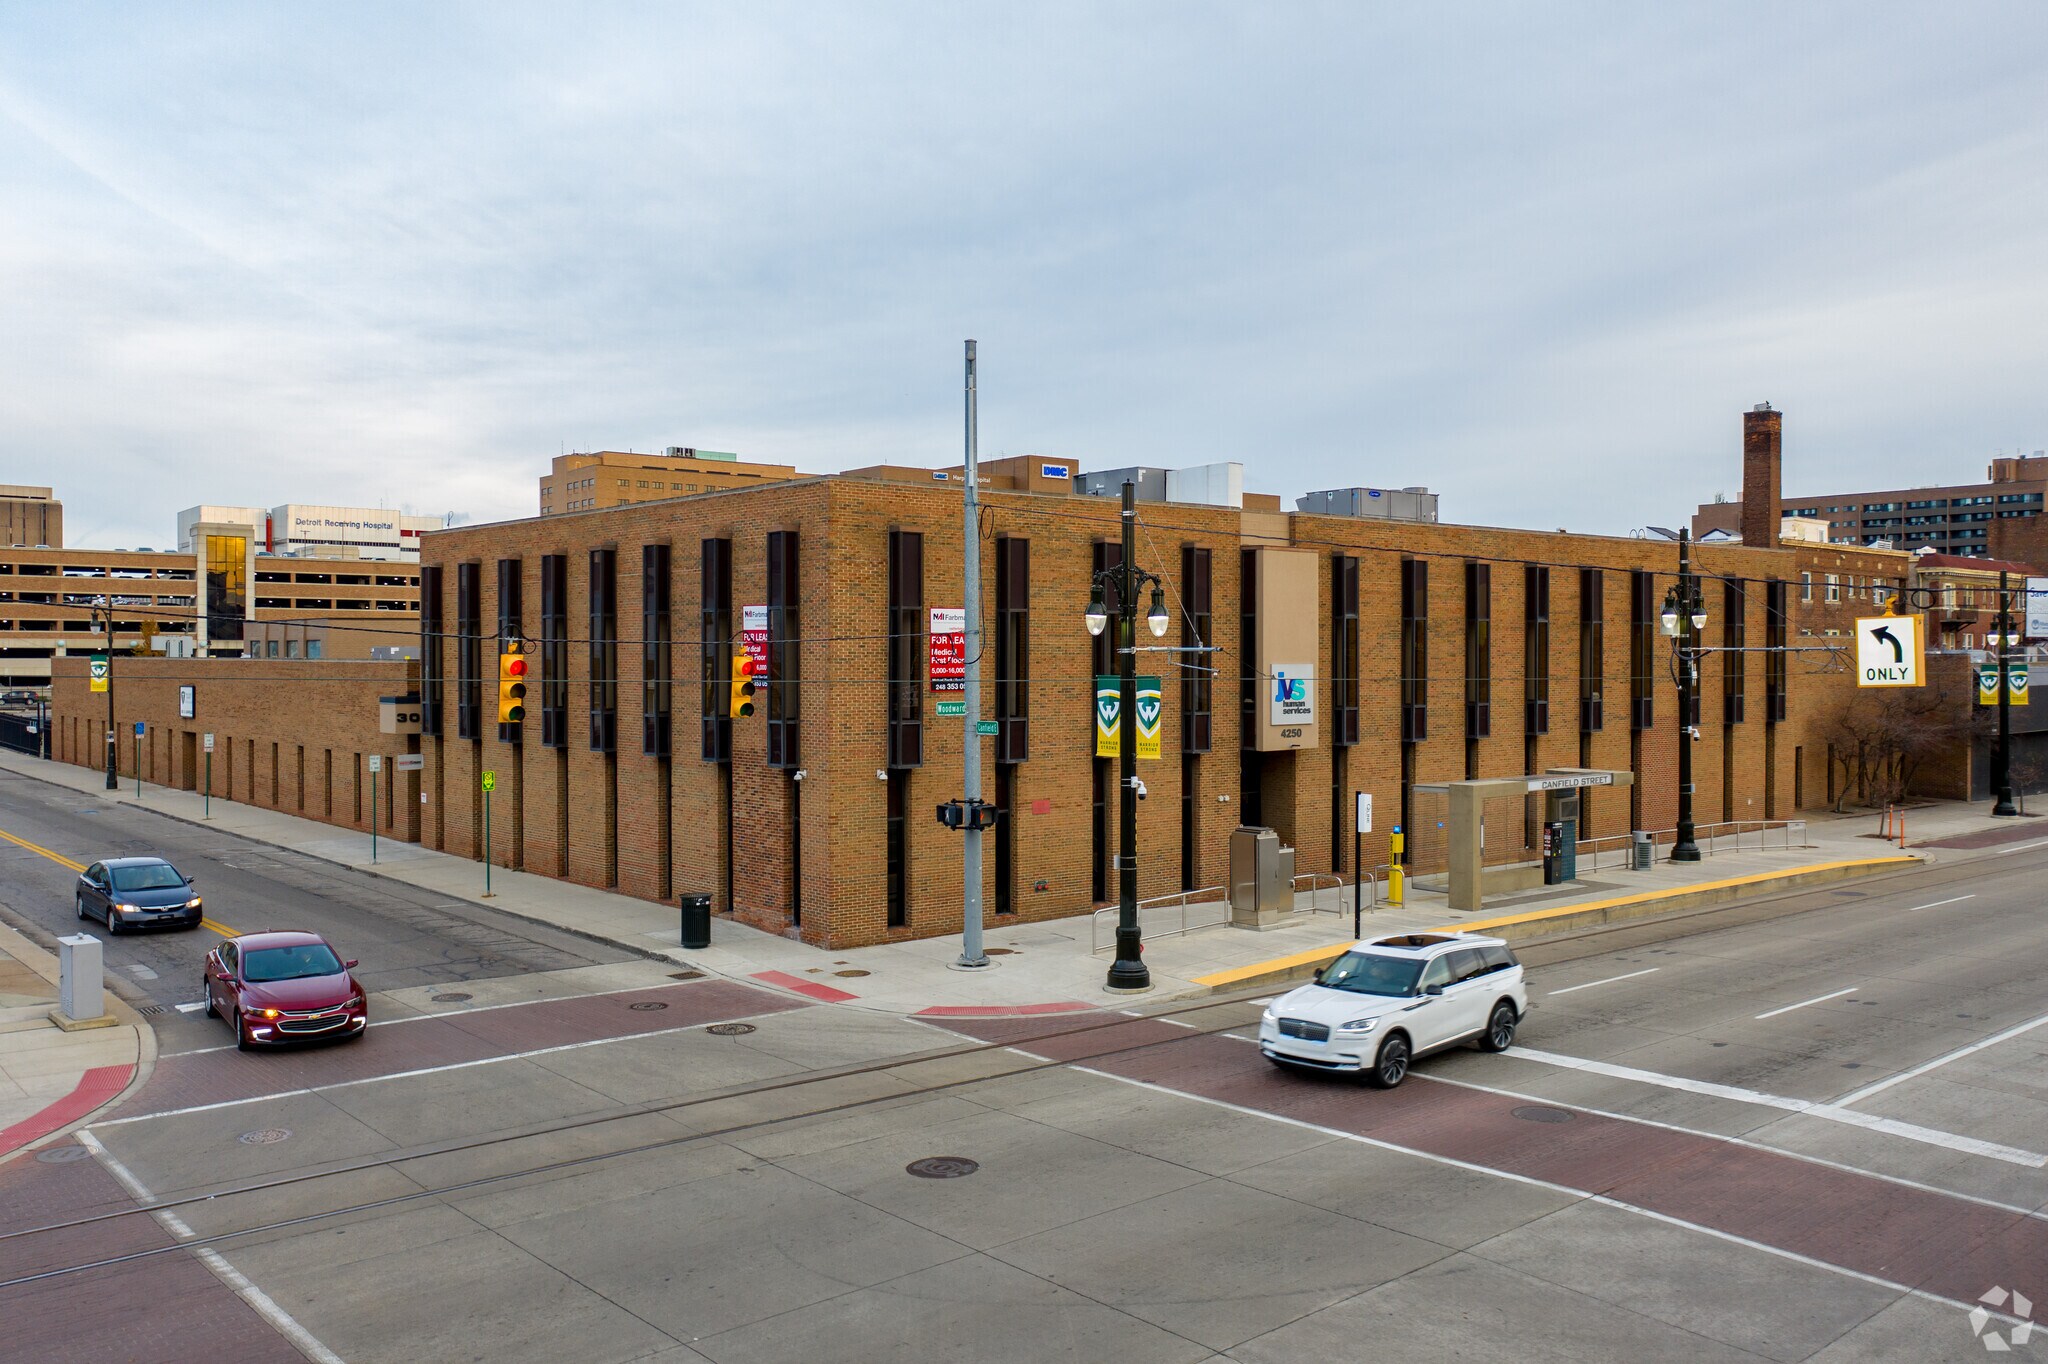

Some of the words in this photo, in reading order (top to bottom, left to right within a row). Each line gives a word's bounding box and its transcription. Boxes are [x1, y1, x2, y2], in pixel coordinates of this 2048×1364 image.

[1044, 466, 1068, 478] DMC
[296, 518, 322, 527] Detroit
[324, 519, 360, 529] Receiving
[363, 522, 393, 530] Hospital
[1866, 667, 1908, 681] ONLY
[1275, 672, 1305, 702] jvs
[1281, 728, 1302, 738] 4250
[1542, 779, 1579, 789] CANFIELD
[1581, 776, 1608, 785] STREET
